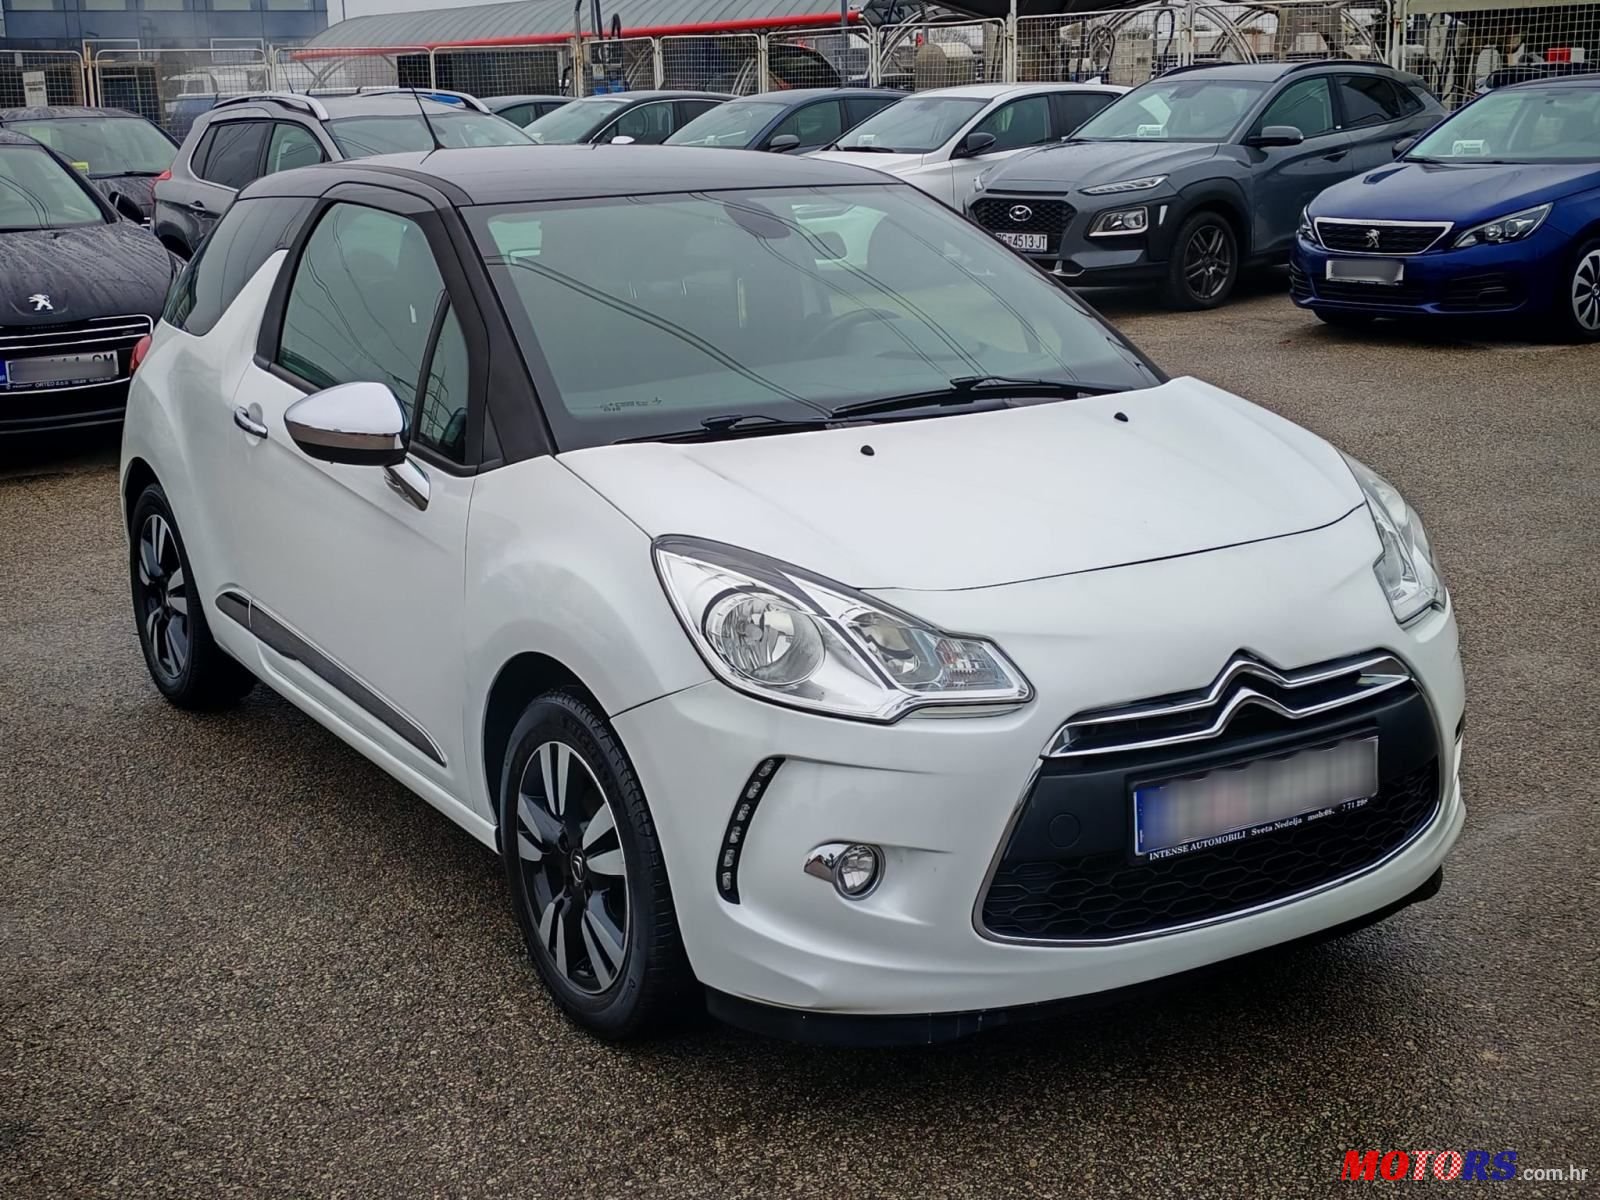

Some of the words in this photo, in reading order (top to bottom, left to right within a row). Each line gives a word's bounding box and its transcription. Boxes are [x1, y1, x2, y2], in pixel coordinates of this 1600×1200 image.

[1149, 844, 1189, 861] INTENSE
[1190, 830, 1247, 851] AUTOMOBILI
[1251, 825, 1273, 836] Sveta
[1274, 816, 1303, 831] Nedelja
